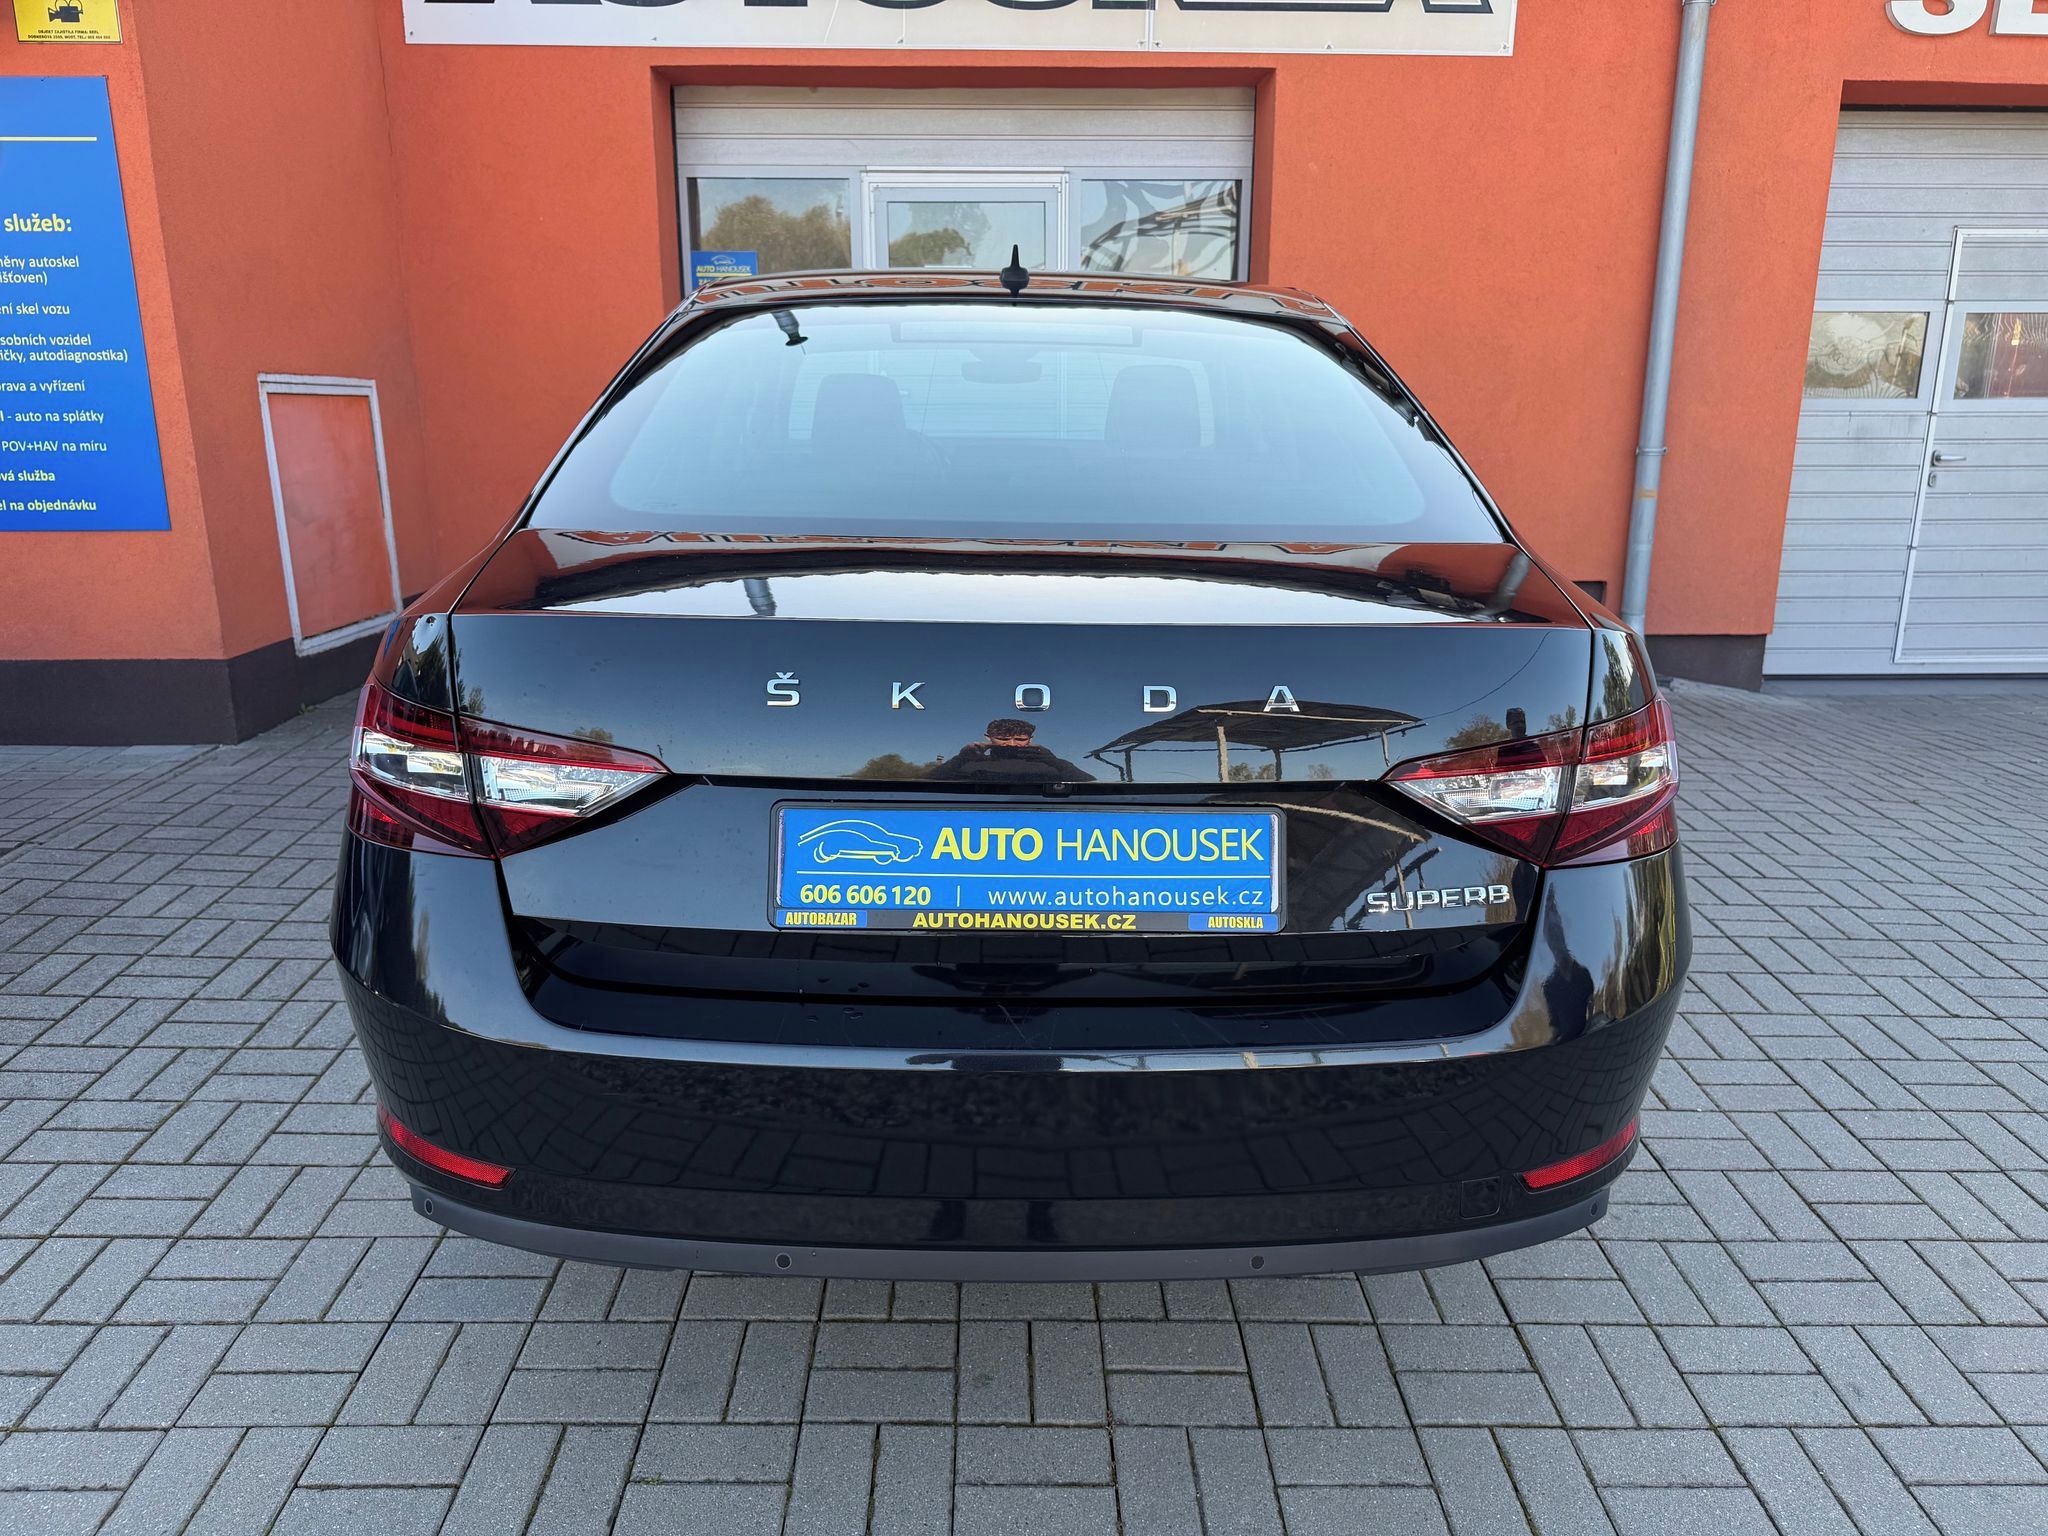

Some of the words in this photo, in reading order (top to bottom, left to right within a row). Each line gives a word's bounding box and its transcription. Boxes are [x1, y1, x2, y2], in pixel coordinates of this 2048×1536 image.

[4, 213, 72, 232] služeb:
[29, 255, 80, 268] autoskel
[0, 302, 13, 315] ní
[16, 303, 39, 315] skel
[42, 305, 70, 315] vozu
[49, 334, 92, 346] vozidel
[29, 349, 128, 363] autodiagnostika)
[29, 382, 37, 392] a
[40, 379, 85, 394] vyřízení
[15, 411, 42, 422] auto
[45, 412, 60, 422] na
[63, 410, 104, 424] splátky
[2, 440, 59, 452] POV+HAV
[62, 443, 77, 452] na
[80, 440, 107, 452] míru
[18, 469, 56, 482] služba
[10, 502, 24, 511] na
[28, 499, 97, 513] objednávku
[766, 671, 1302, 713] ŠKODA
[931, 827, 1044, 861] AUTO
[1057, 828, 1264, 862] HANOUSEK
[800, 884, 842, 904] 606
[846, 885, 887, 905] 606
[891, 886, 932, 906] 120
[987, 884, 1264, 908] www.autohanousek.cz
[1366, 883, 1511, 914] SUPERB
[784, 911, 857, 926] AUTOBAZAR
[912, 912, 1137, 930] AUTOHANOUSEK.CZ
[1207, 916, 1264, 930] AUTOSKLA
